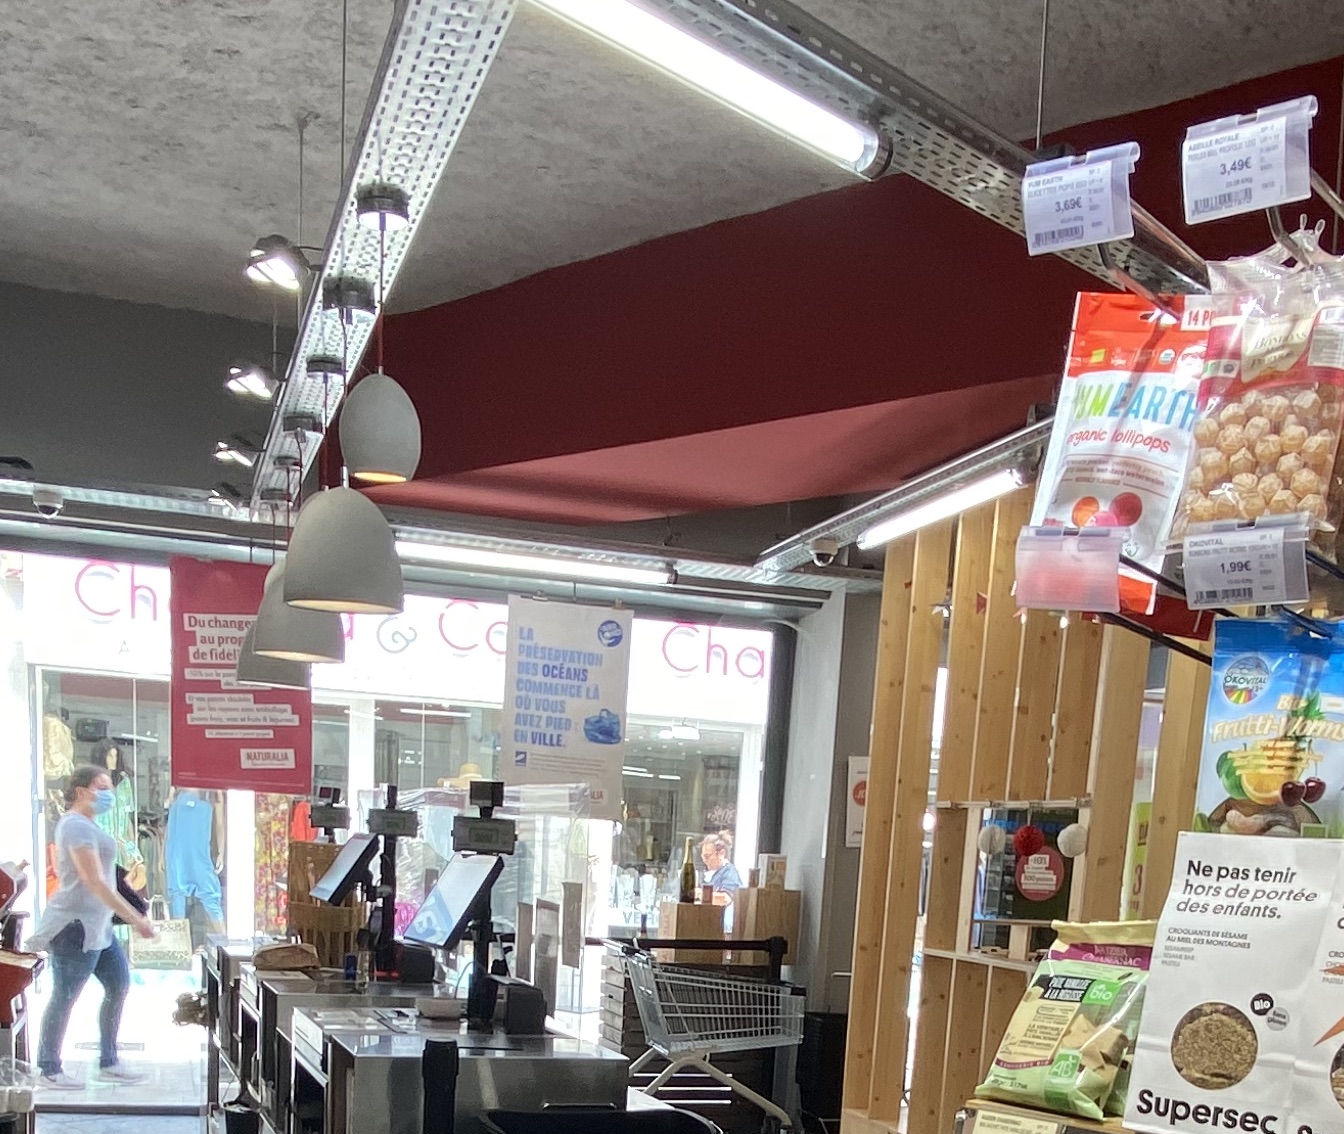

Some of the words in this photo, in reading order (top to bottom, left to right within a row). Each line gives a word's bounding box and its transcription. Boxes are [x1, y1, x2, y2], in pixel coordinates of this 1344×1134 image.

[1219, 158, 1252, 176] 3,49€
[1110, 428, 1171, 454] lollipops
[1219, 561, 1251, 574] 1,99€
[188, 615, 206, 629] Du
[200, 635, 215, 645] au
[519, 627, 534, 641] LA
[193, 650, 207, 660] de
[518, 642, 603, 667] PRÉSERVATION
[517, 661, 538, 676] DES
[542, 663, 588, 682] OCÉANS
[516, 678, 582, 699] COMMENCE
[534, 699, 566, 714] VOUS
[515, 713, 542, 729] AVEZ
[545, 716, 571, 731] PIED
[514, 730, 528, 744] EN
[246, 751, 289, 762] NATURALIA
[1187, 860, 1213, 878] Ne
[1217, 865, 1250, 883] pas
[1255, 865, 1296, 884] tenir
[1182, 879, 1220, 898] hors
[1224, 882, 1249, 900] de
[1252, 884, 1317, 906] portée
[1176, 898, 1208, 916] des
[1212, 900, 1281, 919] enfants.
